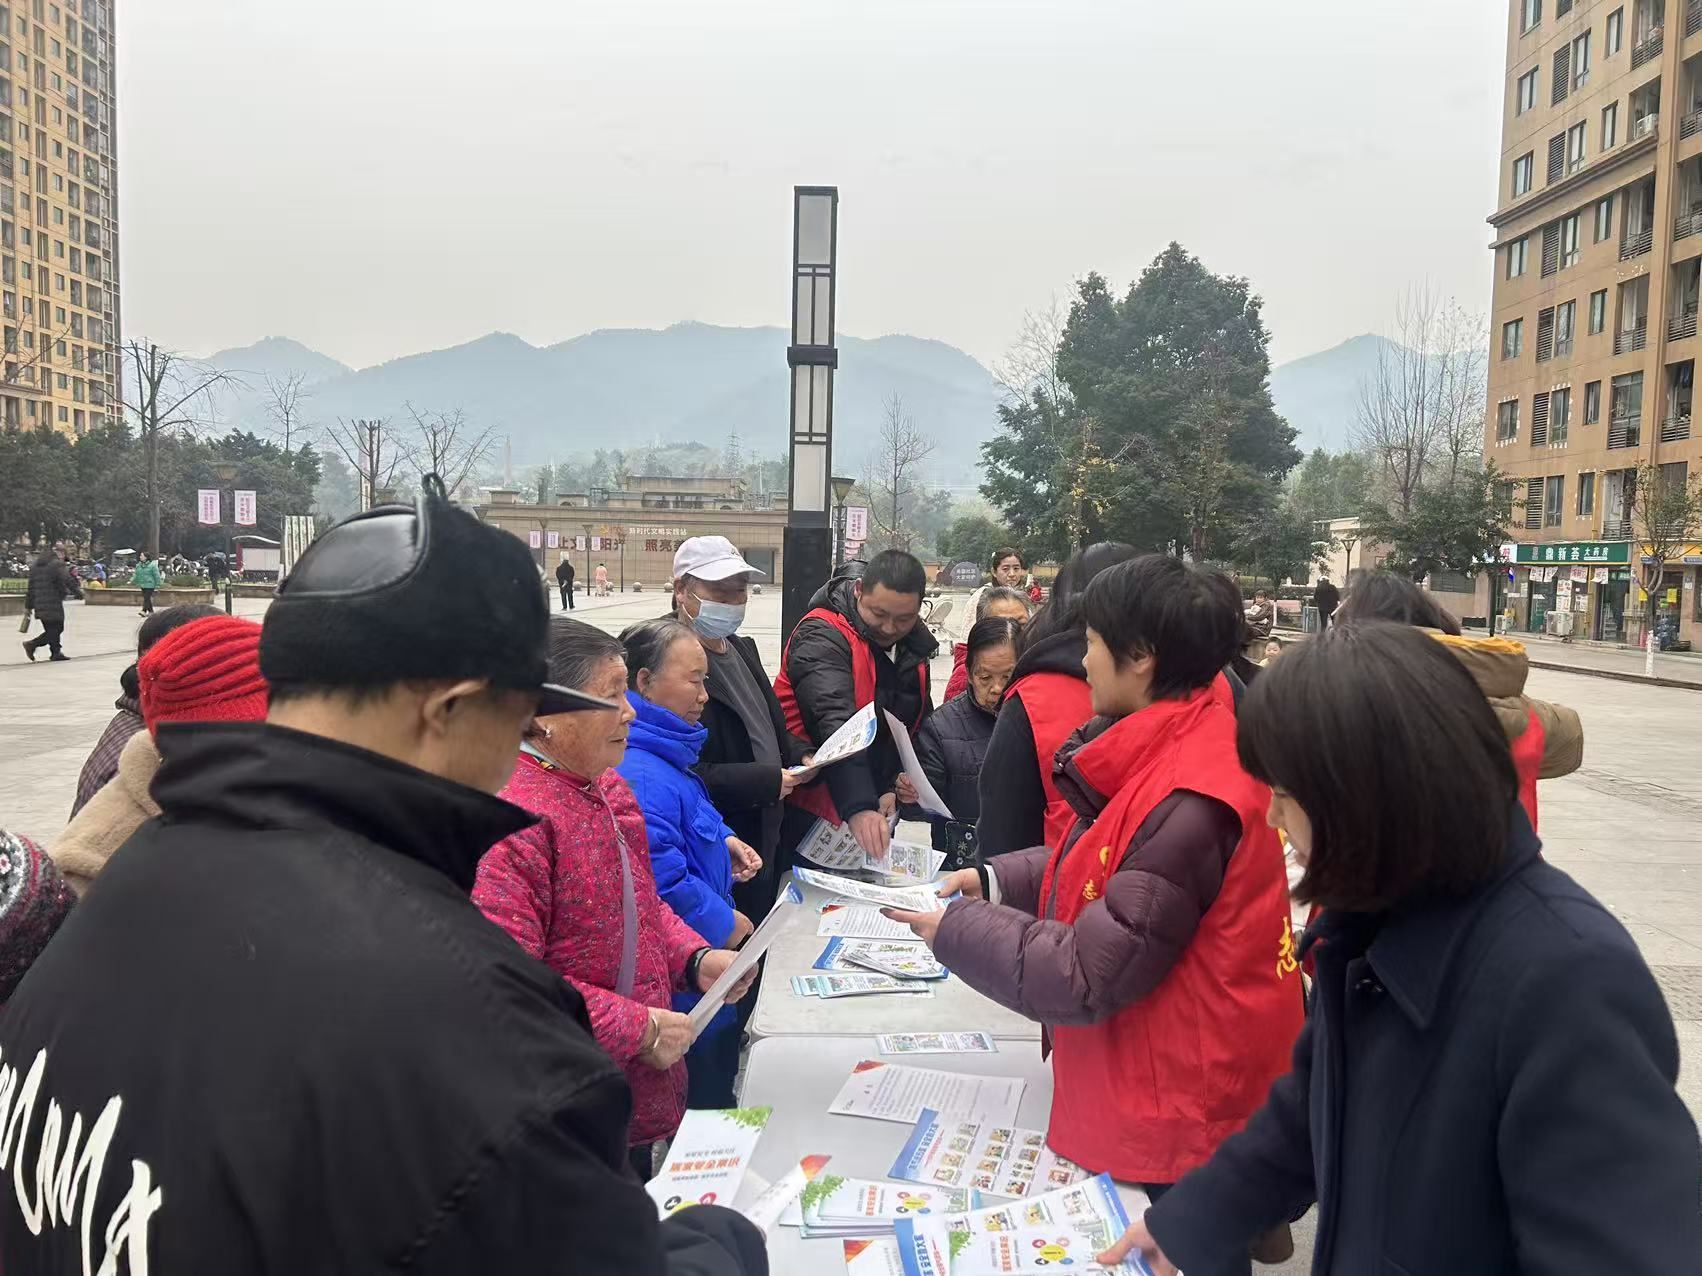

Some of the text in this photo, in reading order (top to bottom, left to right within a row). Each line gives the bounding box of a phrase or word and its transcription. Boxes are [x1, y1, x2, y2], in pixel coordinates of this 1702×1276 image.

[629, 527, 687, 536] 新时代文明实践站
